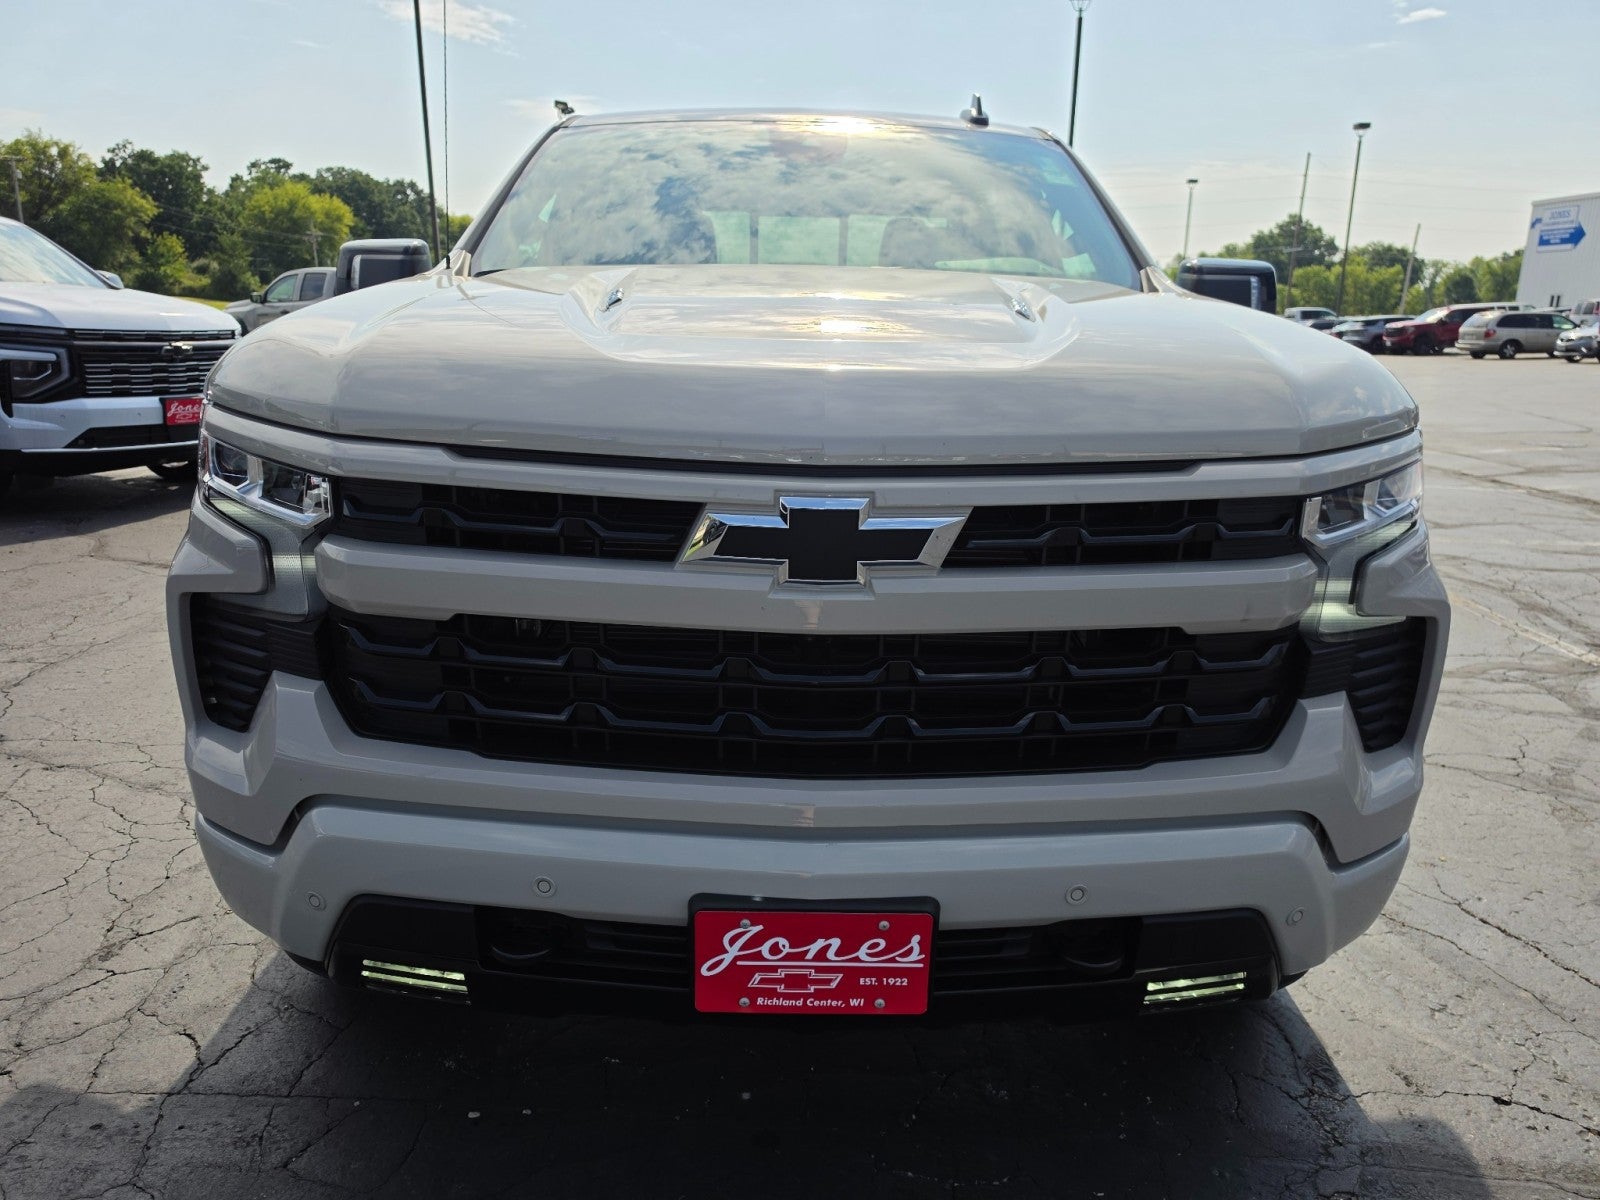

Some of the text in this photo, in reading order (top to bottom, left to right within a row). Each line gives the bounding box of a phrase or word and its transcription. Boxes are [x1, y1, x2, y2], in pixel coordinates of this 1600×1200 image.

[167, 401, 201, 417] Jone
[700, 924, 925, 977] Jones
[859, 977, 908, 986] EST. 1922
[756, 997, 865, 1008] Richland Center, WI
